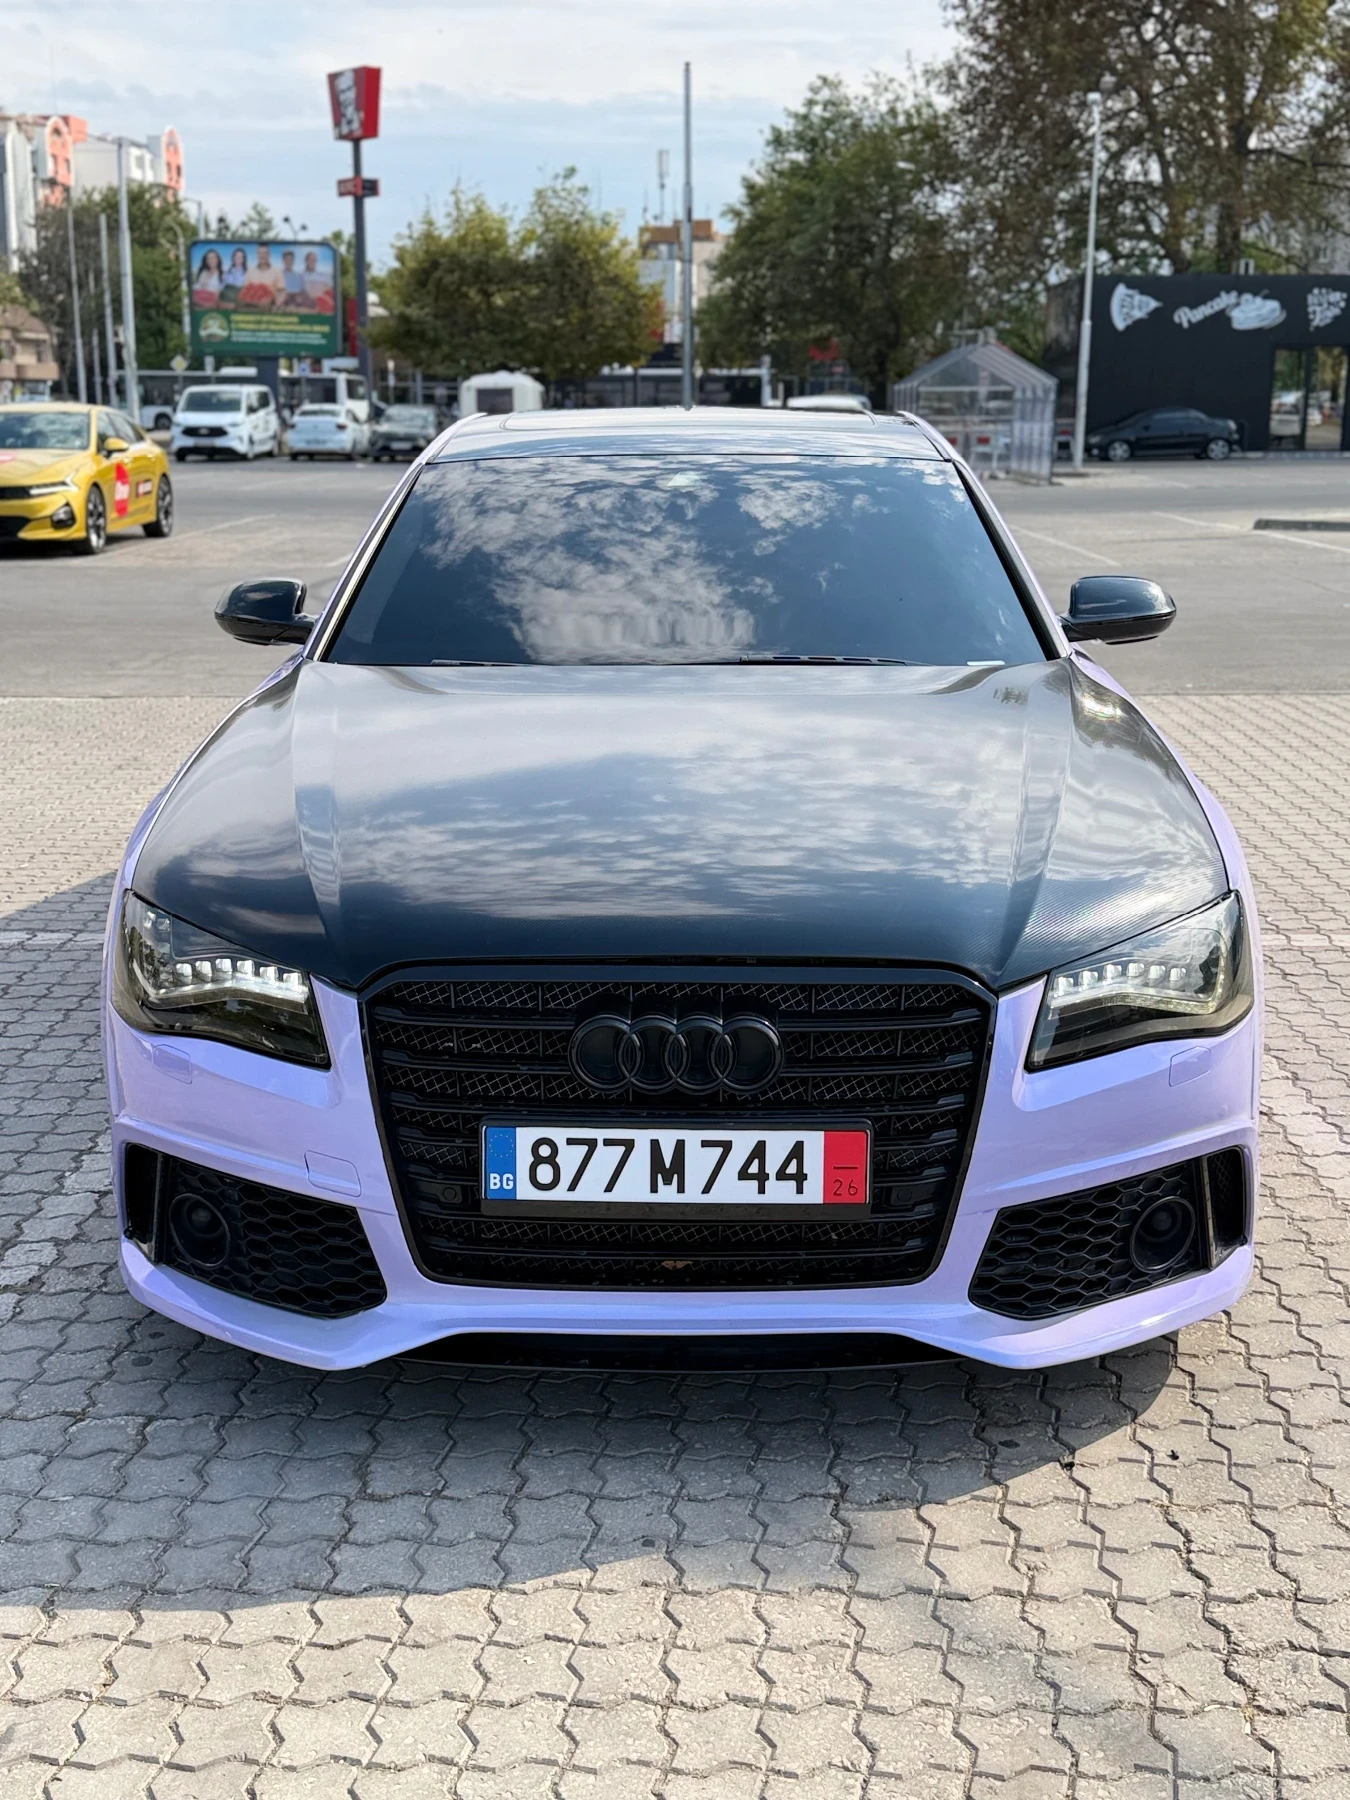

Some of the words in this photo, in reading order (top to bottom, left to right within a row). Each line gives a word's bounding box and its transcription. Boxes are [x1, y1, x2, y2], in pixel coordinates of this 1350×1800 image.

[1172, 289, 1239, 330] Pancake
[489, 1172, 514, 1190] BG
[528, 1137, 635, 1192] 877
[649, 1138, 686, 1194] M
[700, 1139, 808, 1195] 744
[832, 1178, 859, 1197] 26
